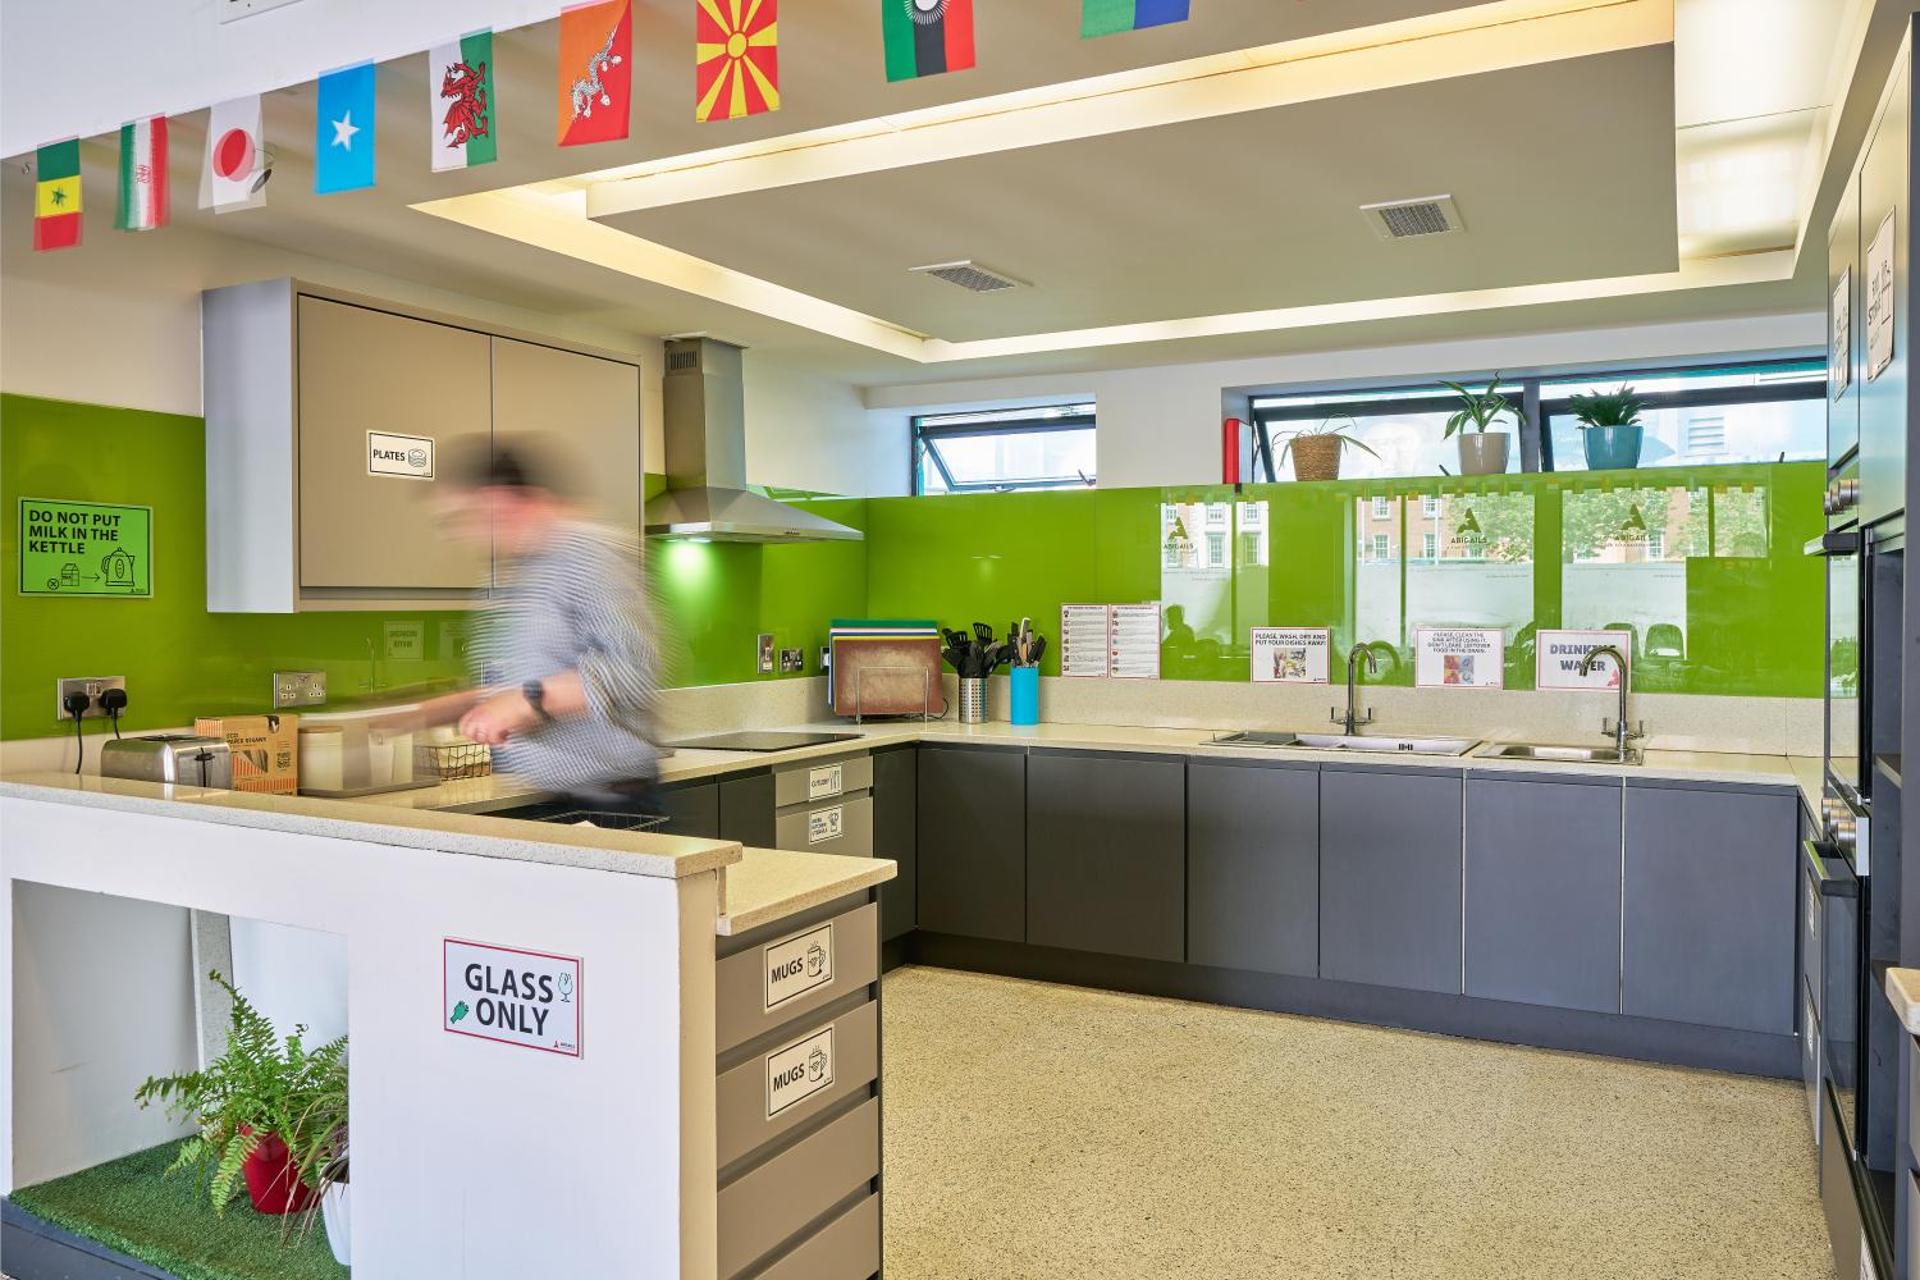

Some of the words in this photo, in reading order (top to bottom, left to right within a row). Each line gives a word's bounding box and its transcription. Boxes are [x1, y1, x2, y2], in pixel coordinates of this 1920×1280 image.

[373, 449, 405, 461] PLATES
[29, 510, 53, 523] DO
[57, 511, 88, 525] NOT
[93, 514, 121, 527] PUT
[29, 526, 68, 539] MILK
[72, 528, 87, 540] IN
[91, 529, 118, 541] THE
[29, 541, 85, 554] KETTLE
[771, 957, 804, 984] MUGS
[465, 963, 554, 1004] GLASS
[476, 998, 549, 1037] ONLY
[773, 1063, 805, 1092] MUGS
